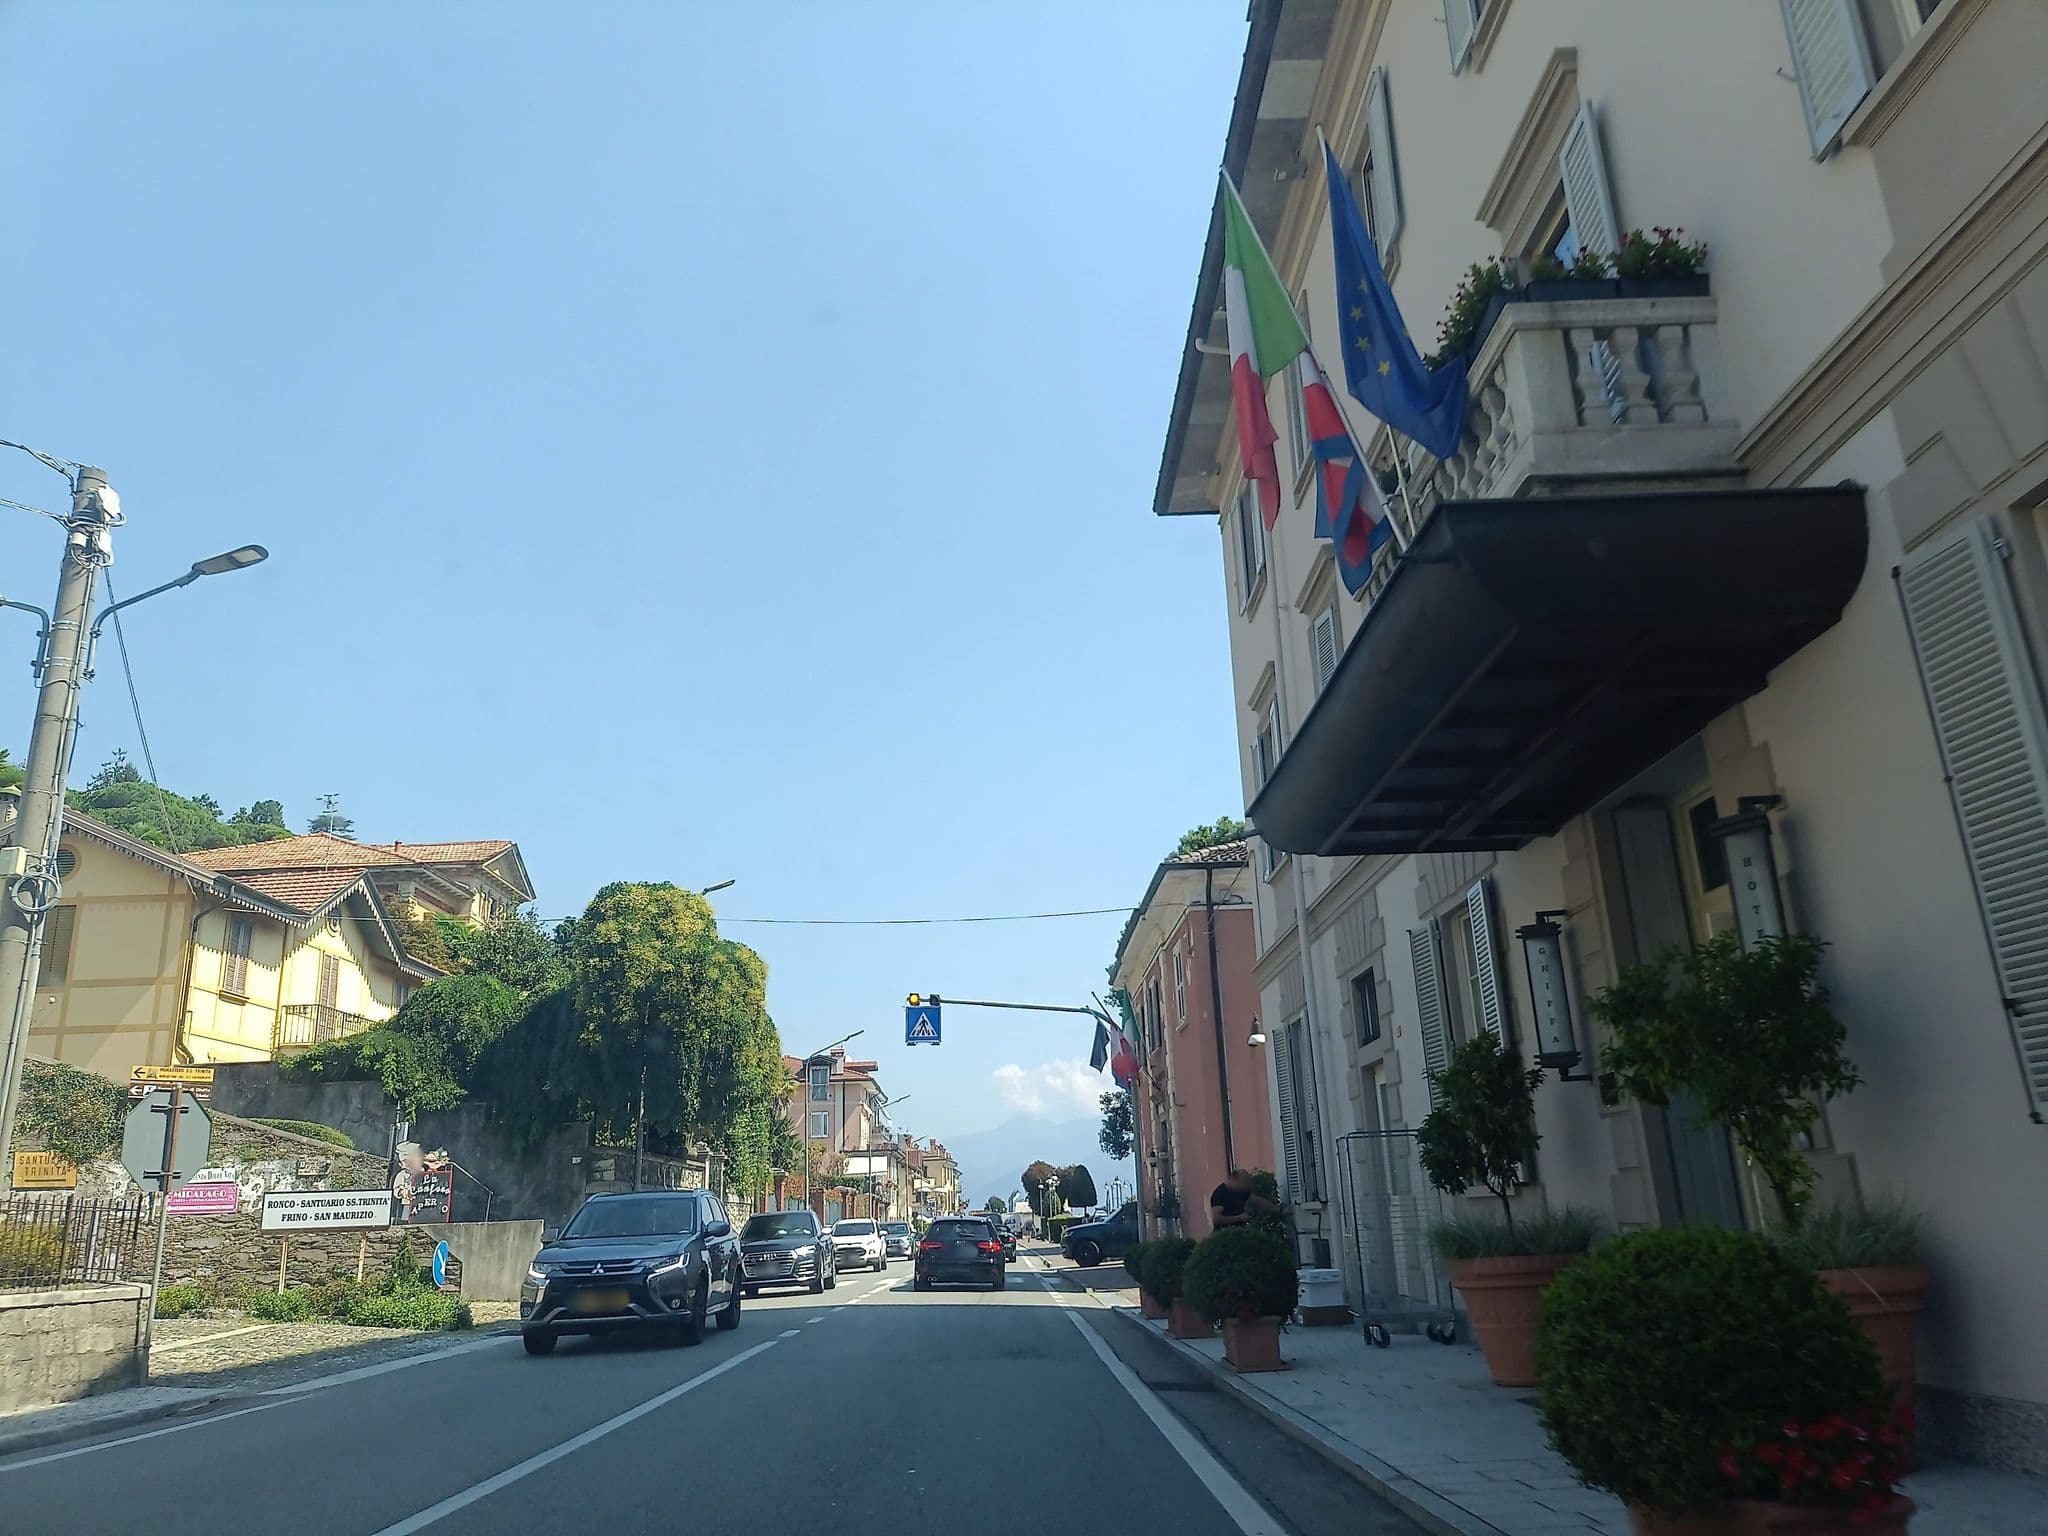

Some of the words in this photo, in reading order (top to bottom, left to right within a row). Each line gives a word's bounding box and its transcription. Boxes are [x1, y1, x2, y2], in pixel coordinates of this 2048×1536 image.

[1538, 947, 1560, 1043] GHIFFA
[267, 1200, 296, 1209] RONCO
[300, 1199, 345, 1208] SANTUARIO
[281, 1213, 308, 1222] FRINO
[314, 1212, 331, 1221] SAN
[332, 1211, 374, 1220] MAURIZIO
